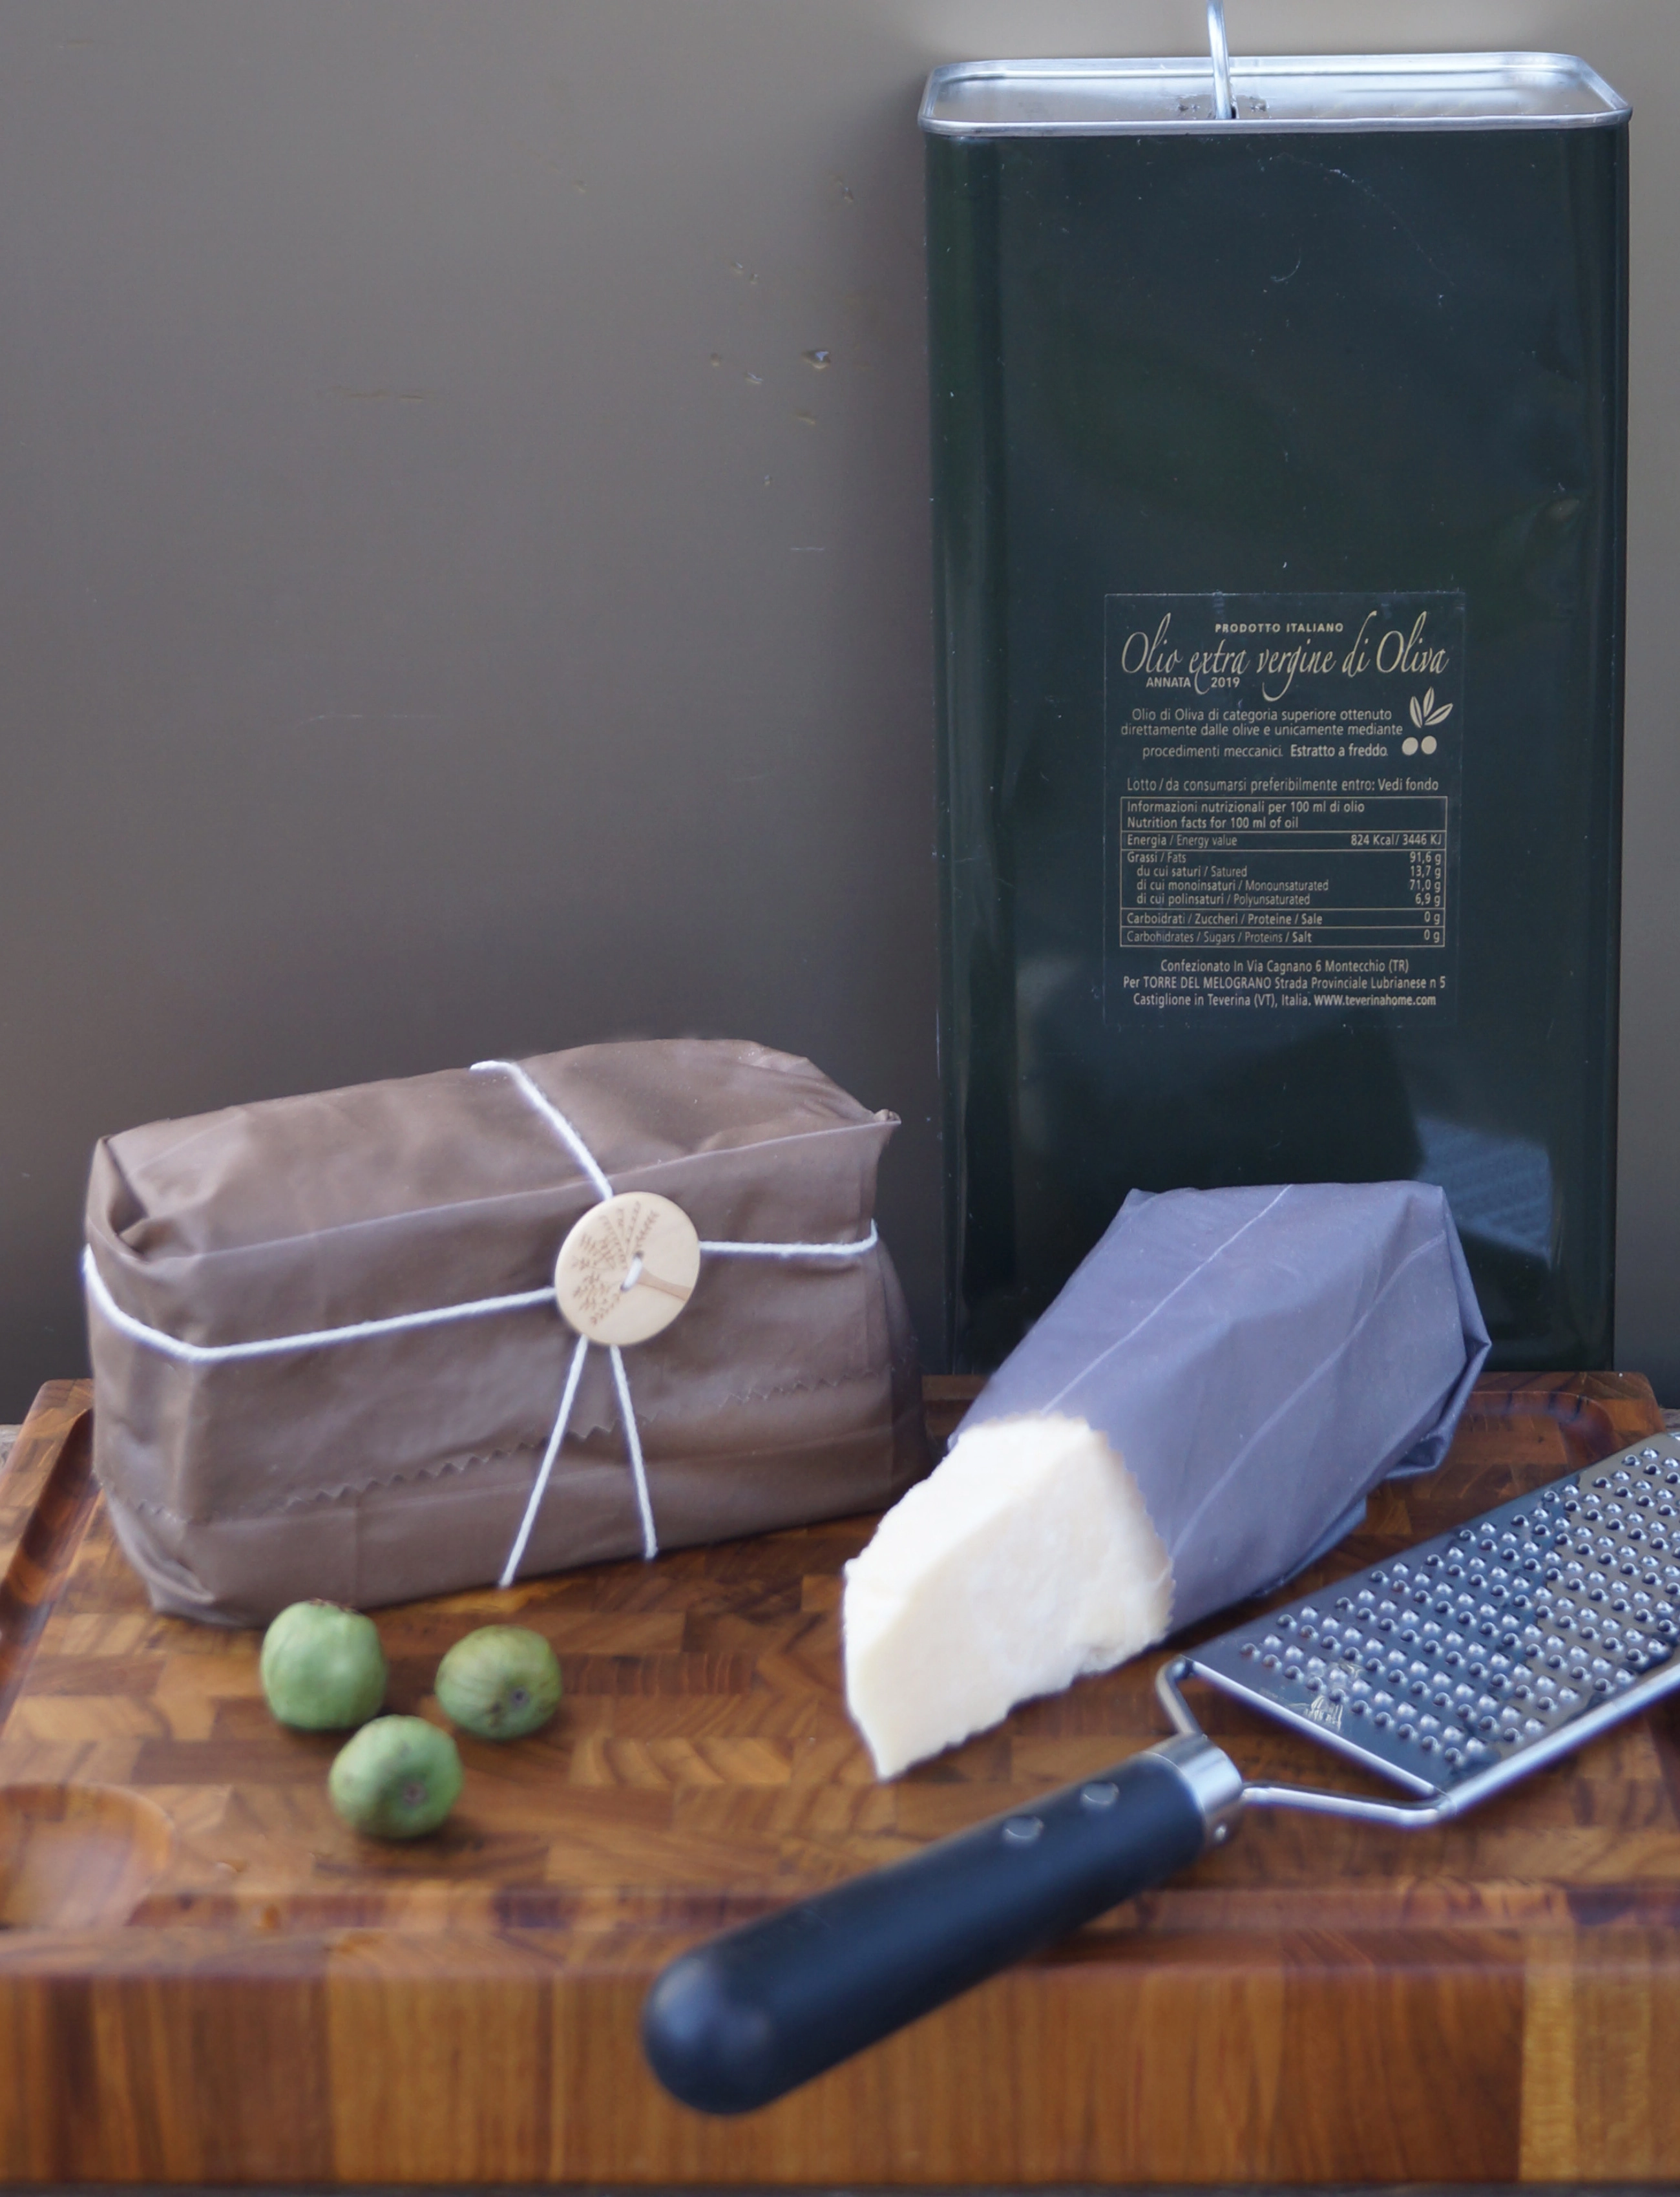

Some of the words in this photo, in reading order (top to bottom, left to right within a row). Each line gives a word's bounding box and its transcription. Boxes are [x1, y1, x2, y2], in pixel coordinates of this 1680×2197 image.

[1215, 623, 1281, 633] PRODOTTO
[1286, 623, 1344, 633] ITALIANO
[1121, 612, 1182, 673] Olio
[1189, 639, 1251, 695] extra
[1257, 638, 1336, 702] vergine
[1342, 611, 1378, 677] di
[1376, 611, 1450, 674] Oliva
[1146, 677, 1192, 688] ANNATA
[1211, 677, 1240, 688] 2019
[1132, 708, 1157, 721] Olio
[1160, 709, 1171, 721] di
[1175, 708, 1204, 721] Oliva
[1208, 709, 1219, 721] di
[1223, 709, 1277, 724] categoria
[1281, 709, 1336, 724] superiore
[1339, 709, 1392, 721] ottenuto
[1121, 723, 1197, 736] direttamente
[1201, 723, 1229, 736] dalle
[1233, 723, 1259, 736] olive
[1264, 726, 1271, 736] e
[1275, 723, 1344, 736] unicamente
[1348, 723, 1403, 736] mediante
[1142, 744, 1219, 760] procedimenti
[1291, 744, 1335, 757] Estratto
[1338, 747, 1345, 757] a
[1184, 779, 1247, 792] consumarsi
[1251, 778, 1338, 794] preferibilmente
[1341, 779, 1375, 792] entro:
[1378, 778, 1403, 791] Vedi
[1406, 778, 1438, 791] fondo
[1128, 801, 1198, 813] Informazioni
[1201, 801, 1265, 813] nutrizionali
[1268, 804, 1286, 815] per
[1291, 801, 1309, 813] 100
[1313, 801, 1327, 813] ml
[1330, 801, 1340, 813] di
[1343, 801, 1365, 813] olio
[1128, 817, 1178, 829] Nutrition
[1181, 817, 1207, 829] facts
[1210, 817, 1227, 829] for
[1230, 817, 1248, 829] 100
[1252, 817, 1266, 829] ml
[1269, 817, 1283, 829] of
[1285, 817, 1299, 829] oil
[1127, 834, 1166, 848] Energia
[1177, 834, 1209, 848] Energy
[1212, 835, 1237, 846] value
[1350, 834, 1370, 845] 824
[1403, 834, 1427, 845] 3446
[1430, 834, 1442, 845] KJ
[1128, 852, 1158, 863] Grassi
[1168, 852, 1186, 863] Fats
[1409, 852, 1432, 864] 91,6
[1435, 855, 1442, 865] g
[1137, 867, 1150, 877] du
[1153, 867, 1168, 877] cui
[1171, 867, 1201, 877] saturi
[1211, 867, 1247, 877] Satured
[1411, 866, 1431, 878] 13,7
[1434, 868, 1441, 879] g
[1137, 880, 1146, 891] di
[1150, 880, 1164, 891] cui
[1168, 880, 1235, 891] monoinsaturi
[1246, 880, 1328, 891] Monounsaturated
[1409, 879, 1431, 892] 71,0
[1434, 882, 1441, 893] g
[1137, 894, 1146, 905] di
[1150, 894, 1164, 905] cui
[1168, 894, 1224, 907] polinsaturi
[1234, 894, 1310, 907] Polyunsaturated
[1415, 894, 1431, 906] 6,9
[1434, 896, 1441, 907] g
[1127, 912, 1186, 925] Carboidrati
[1195, 912, 1239, 925] Zuccheri
[1248, 912, 1290, 925] Proteine
[1301, 912, 1323, 925] Sale
[1424, 912, 1431, 923] 0
[1433, 915, 1440, 925] g
[1204, 930, 1235, 945] Sugars
[1245, 930, 1282, 943] Proteins
[1292, 930, 1312, 943] Salt
[1424, 930, 1430, 941] 0
[1433, 932, 1440, 943] g
[1160, 960, 1231, 972] Confezionato
[1234, 960, 1244, 972] In
[1247, 960, 1264, 972] Via
[1267, 960, 1312, 974] Cagnano
[1315, 960, 1321, 972] 6
[1325, 960, 1385, 972] Montecchio
[1388, 959, 1409, 974] (TR)
[1124, 976, 1140, 989] Per
[1144, 976, 1177, 989] TORRE
[1181, 976, 1200, 989] DEL
[1203, 976, 1272, 989] MELOGRANO
[1274, 976, 1307, 989] Strada
[1311, 976, 1368, 989] Provinciale
[1370, 976, 1427, 989] Lubrianese
[1440, 976, 1446, 988] 5
[1133, 994, 1192, 1008] Castiglione
[1194, 994, 1204, 1006] in
[1208, 994, 1250, 1006] Teverina
[1281, 994, 1311, 1006] Italia.
